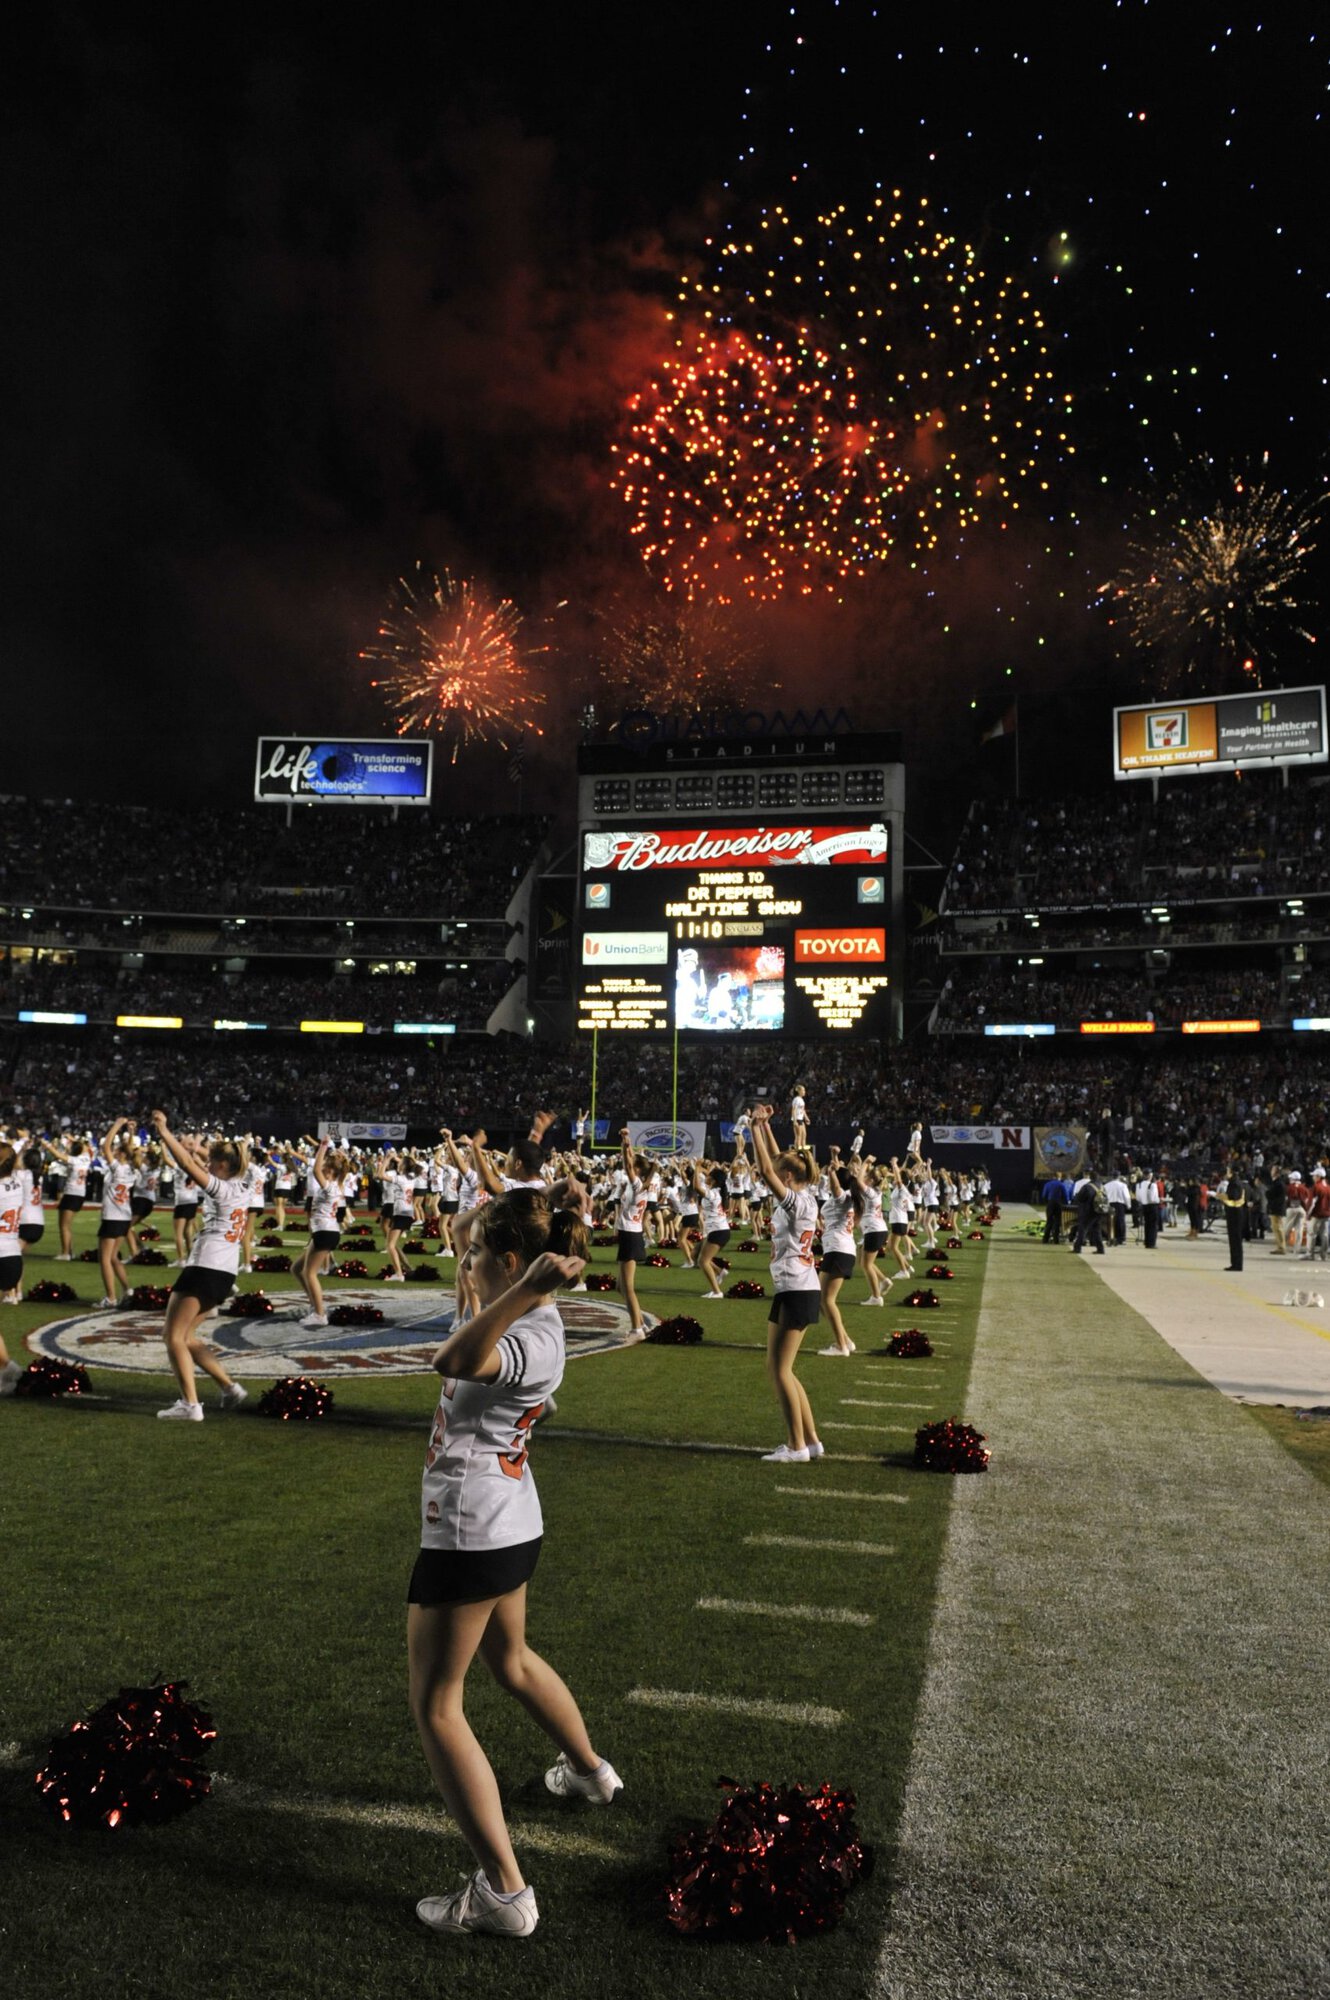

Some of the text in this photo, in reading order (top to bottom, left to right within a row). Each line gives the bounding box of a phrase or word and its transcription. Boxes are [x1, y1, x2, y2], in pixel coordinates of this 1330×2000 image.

[1221, 720, 1319, 739] Imaging Healthcare
[665, 740, 836, 760] STADIUM
[1226, 745, 1243, 754] Your
[1244, 742, 1273, 752] Partner
[1284, 738, 1310, 748] Health
[353, 753, 422, 767] Transforming
[1139, 752, 1174, 764] THANK
[260, 744, 317, 793] life
[367, 764, 407, 774] science
[612, 827, 812, 871] Budweiser
[814, 836, 886, 858] American Lager
[699, 871, 765, 885] THANKS TO
[687, 885, 775, 901] DR PEPPER
[666, 900, 802, 917] HALFTIME SHOW
[676, 921, 723, 939] 11:10
[604, 943, 666, 954] UnionBank
[799, 938, 882, 955] TOYOTA
[1082, 1022, 1154, 1033] WELLS FARGO
[645, 1127, 672, 1139] PACIFIC
[1001, 1128, 1023, 1148] N
